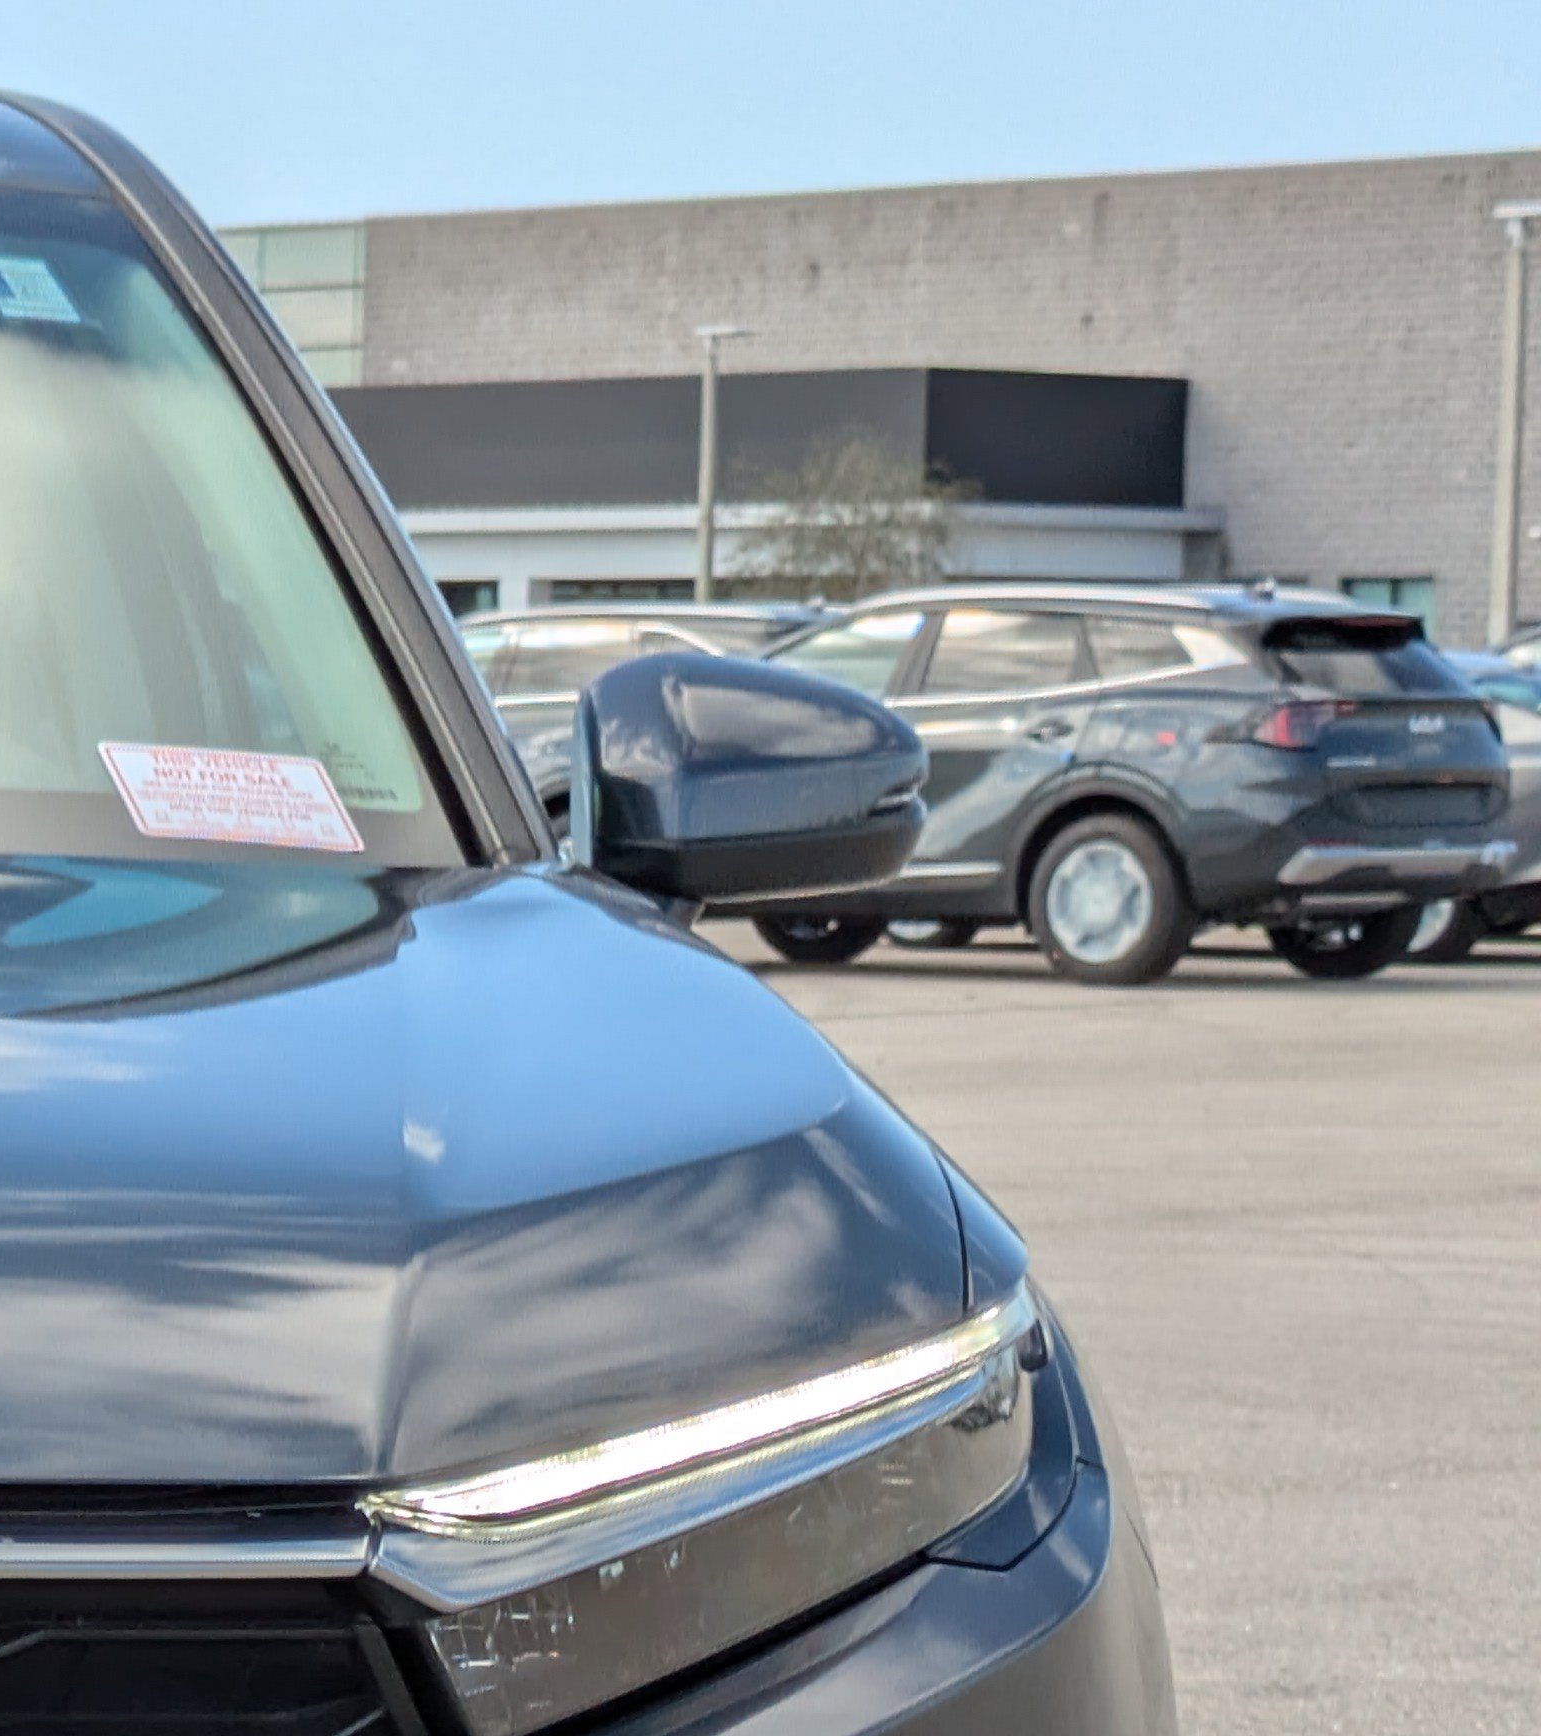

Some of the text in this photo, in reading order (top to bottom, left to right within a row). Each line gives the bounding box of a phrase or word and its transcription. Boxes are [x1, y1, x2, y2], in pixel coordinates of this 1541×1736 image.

[152, 767, 292, 789] NOT FOR SALE
